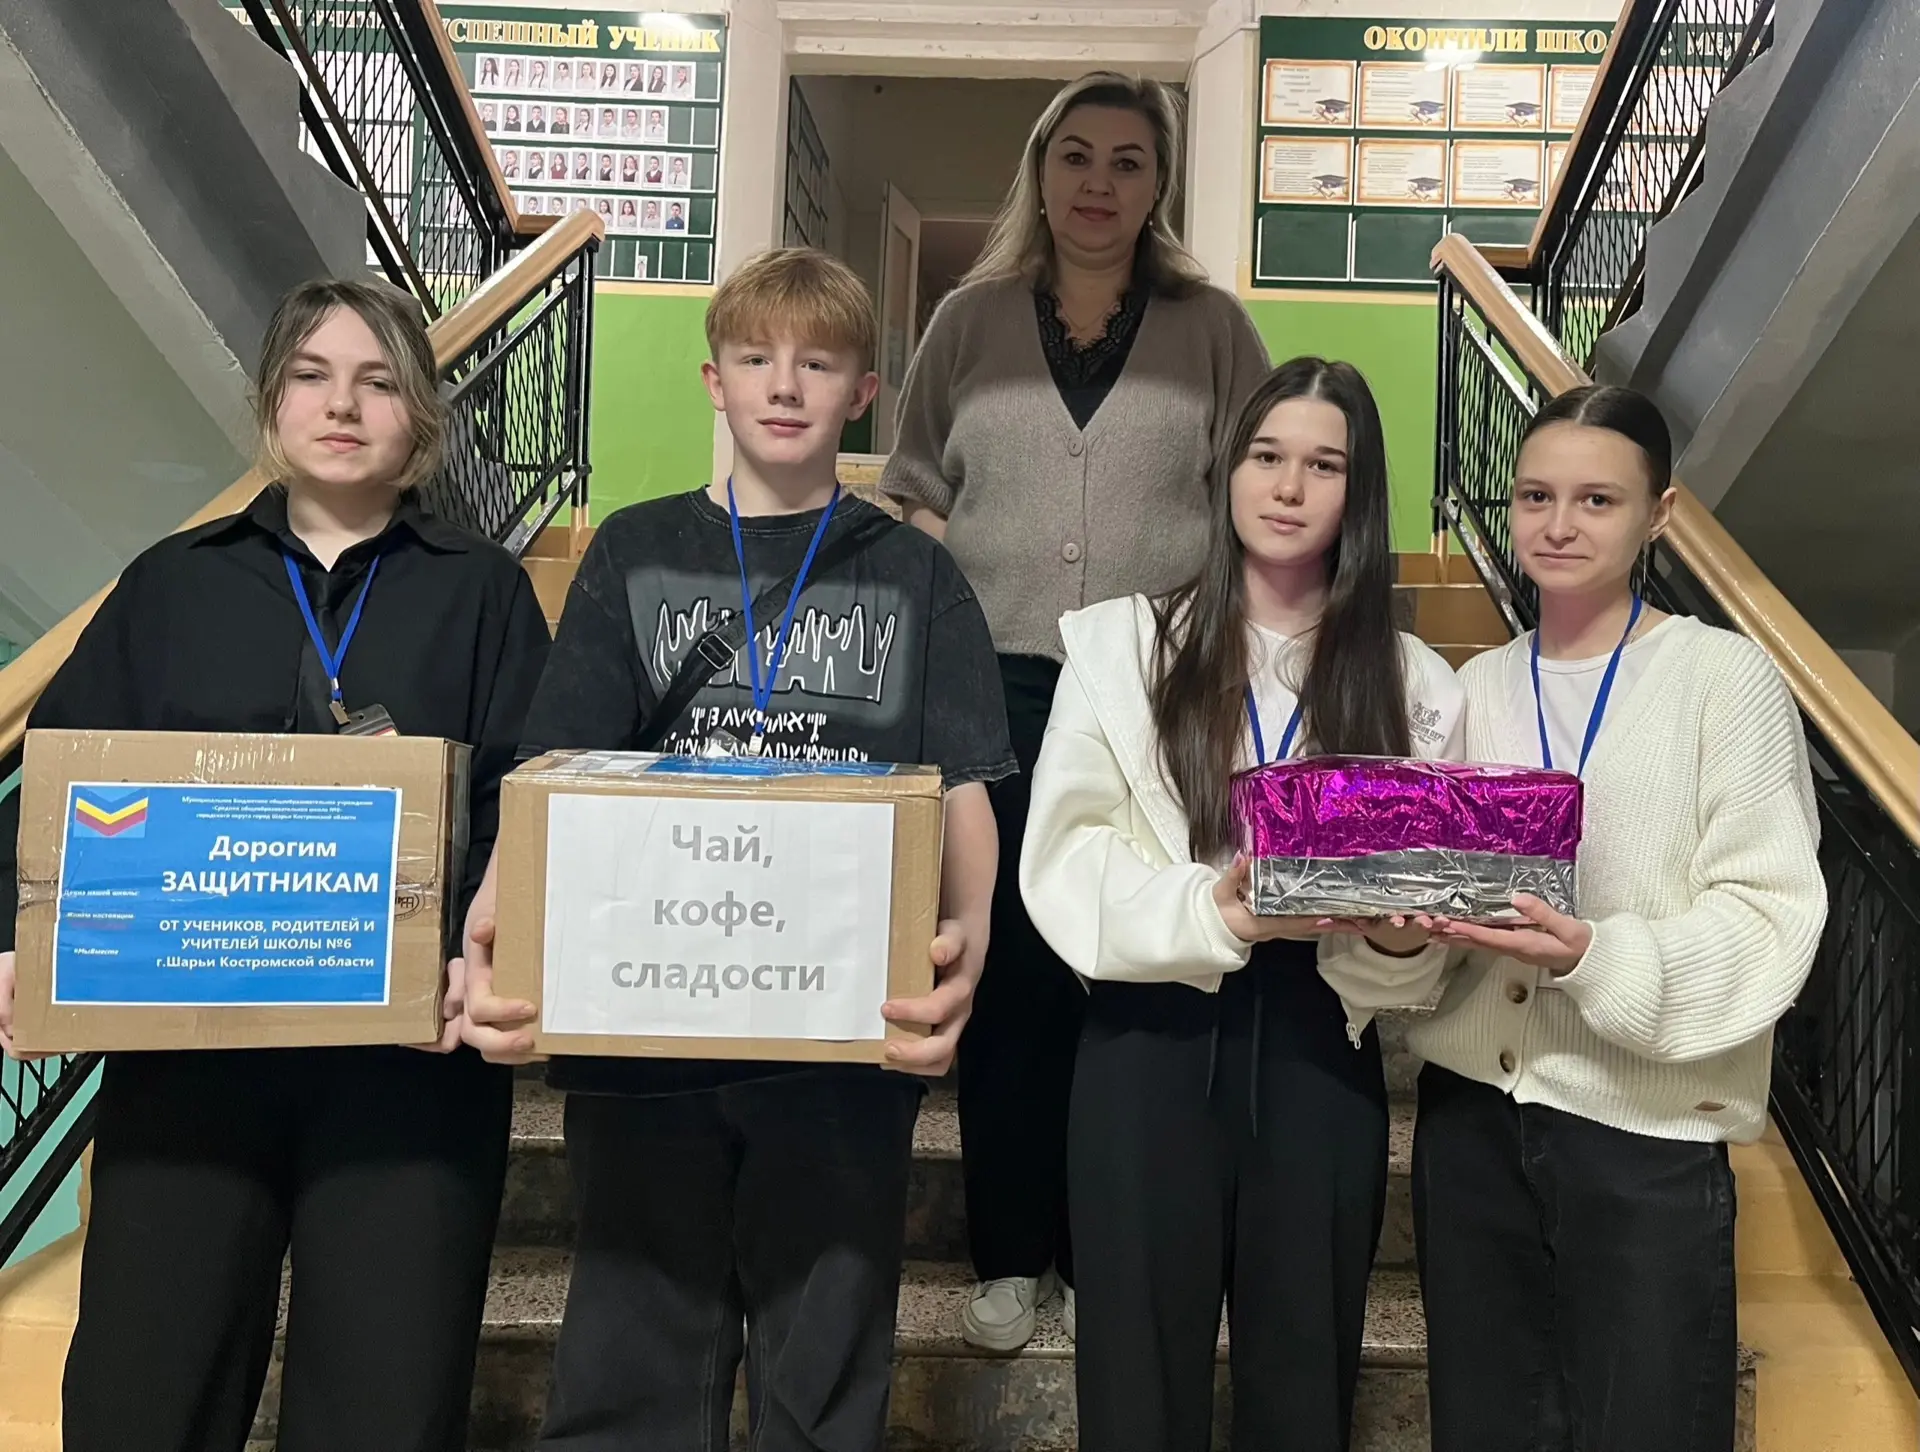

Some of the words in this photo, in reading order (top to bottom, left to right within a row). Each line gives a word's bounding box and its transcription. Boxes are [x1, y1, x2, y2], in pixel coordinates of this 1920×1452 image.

[608, 25, 720, 52] УЧЕНИК
[1363, 25, 1528, 52] ОКОНЧИЛИ
[1535, 29, 1613, 54] ШКО
[208, 835, 337, 862] Дорогим
[672, 824, 773, 869] Чай,
[161, 870, 379, 897] ЗАЩИТНИКАМ
[159, 919, 180, 932] ОТ
[183, 919, 267, 933] УЧЕНИКОВ,
[271, 916, 360, 933] РОДИТЕЛЕЙ
[364, 920, 375, 932] И
[653, 890, 786, 938] кофе,
[181, 935, 259, 950] УЧИТЕЛЕЙ
[264, 937, 322, 950] ШКОЛЫ
[326, 938, 352, 949] №6
[156, 955, 216, 971] г.Шарьи
[220, 954, 314, 971] Костромской
[318, 955, 375, 968] области
[611, 961, 825, 999] сладости
